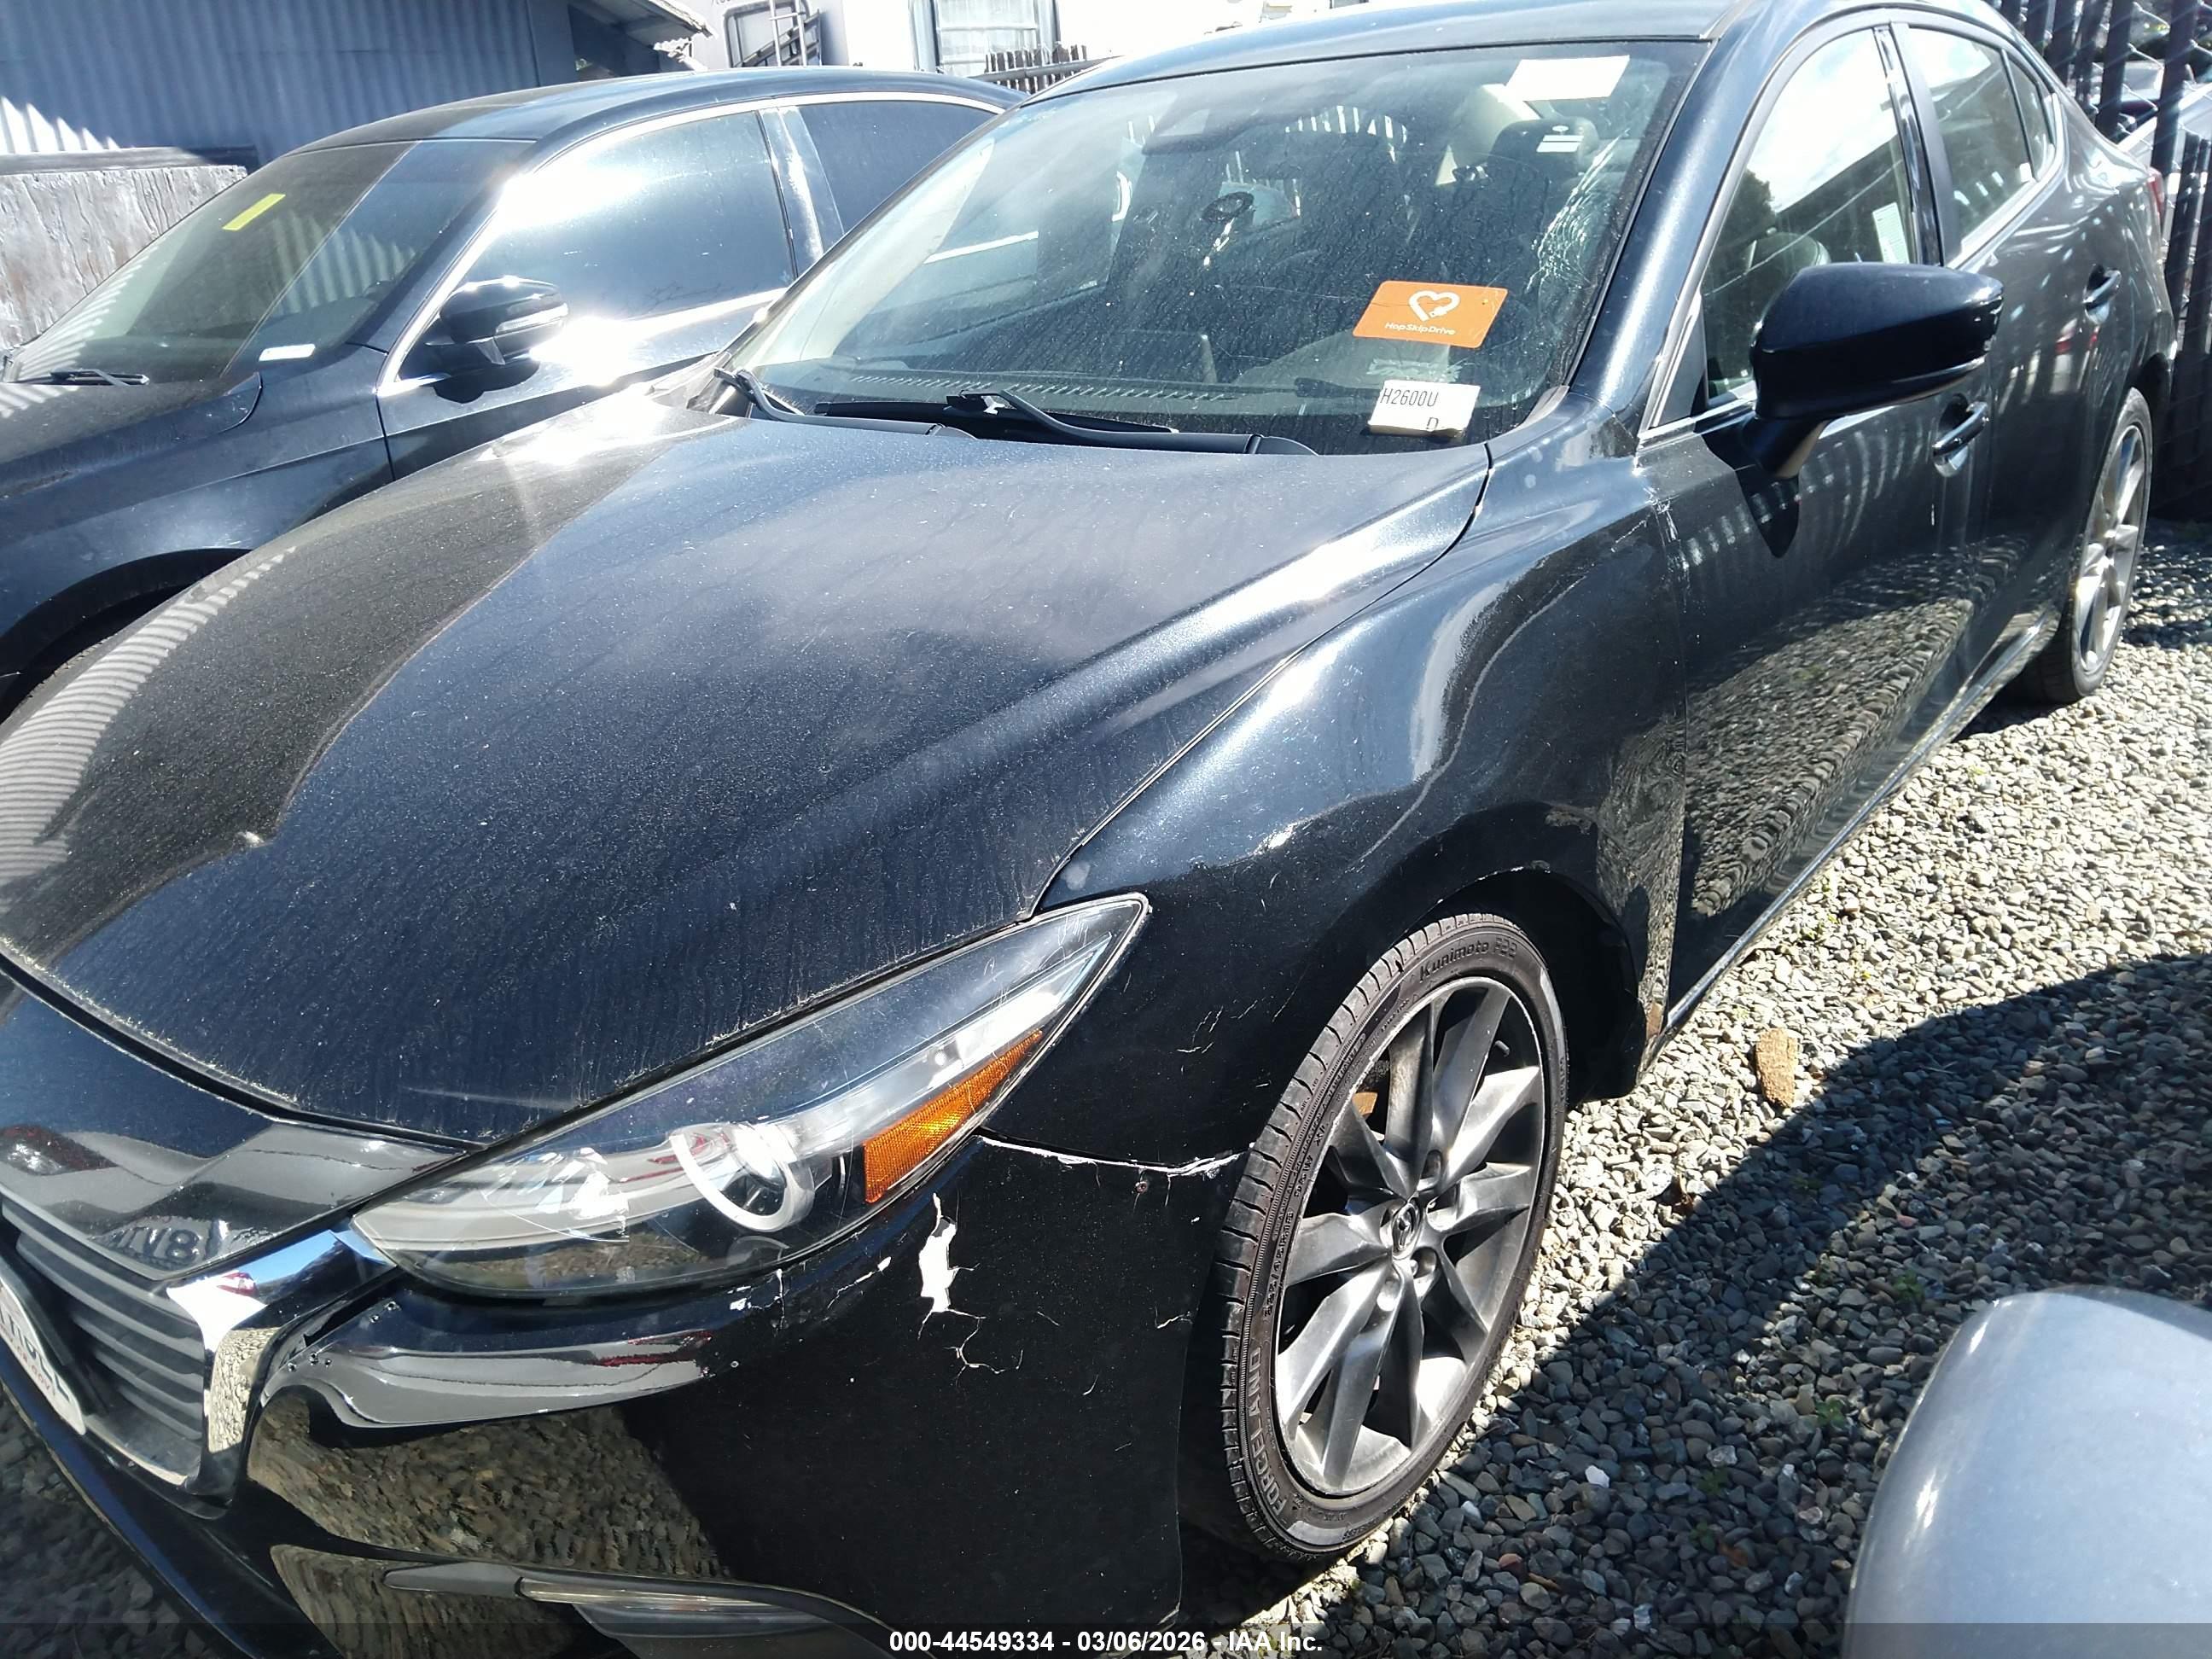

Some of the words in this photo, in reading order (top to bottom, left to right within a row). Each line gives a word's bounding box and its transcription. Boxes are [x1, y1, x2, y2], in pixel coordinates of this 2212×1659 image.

[1384, 322, 1457, 335] HopSkipDrive
[1379, 387, 1439, 408] H2600U
[1419, 940, 1489, 982] Kunimoto
[1248, 1347, 1287, 1517] FORCELAND
